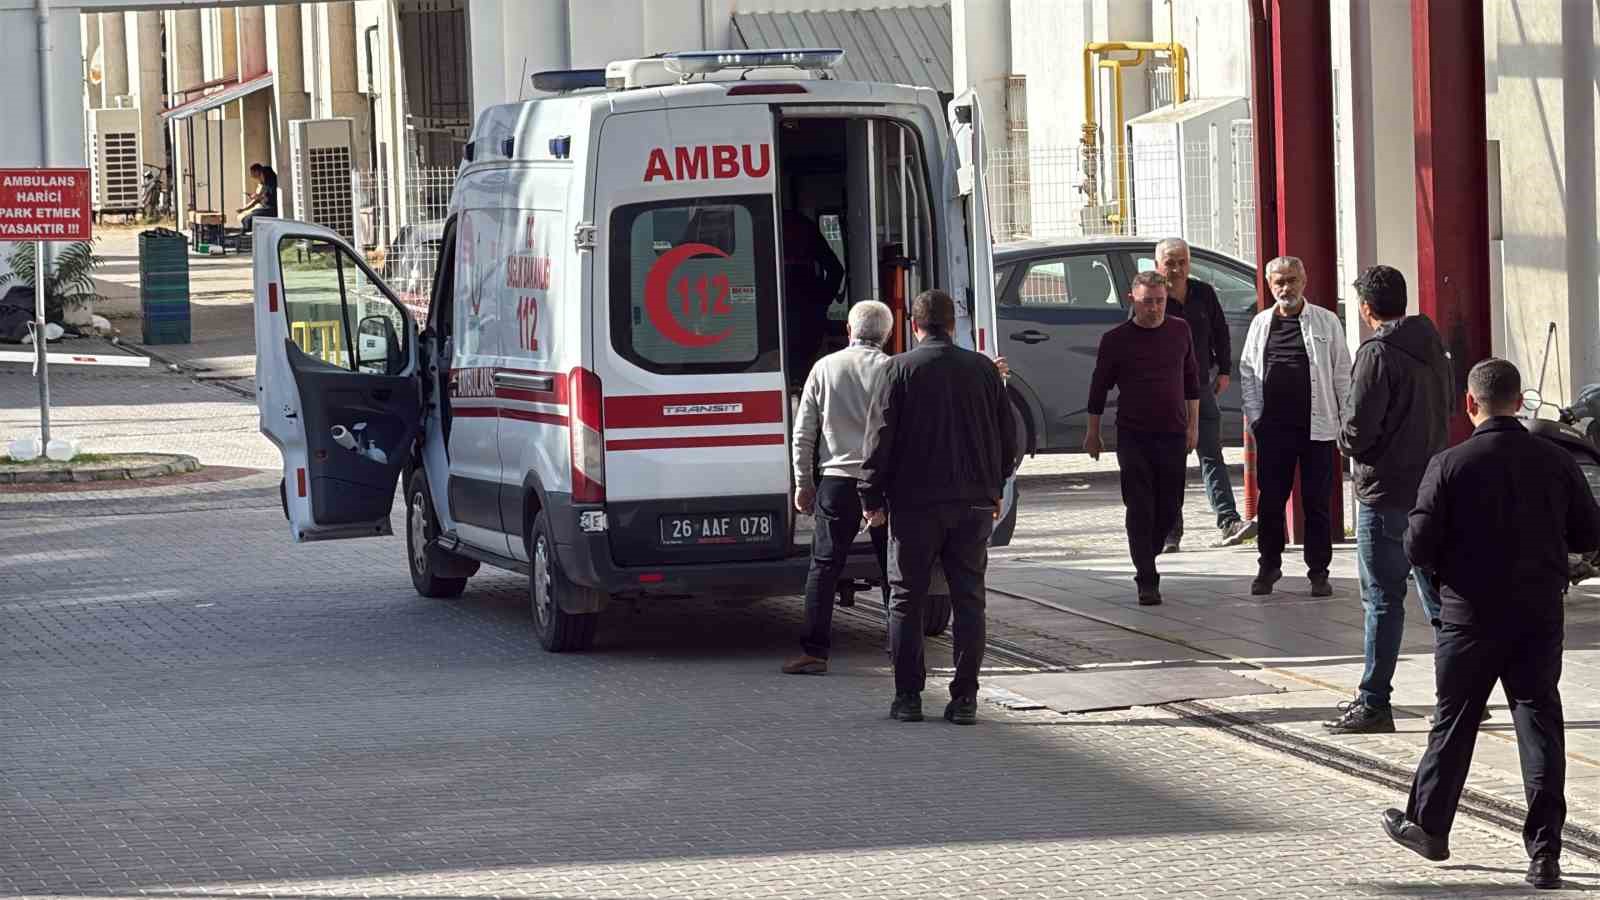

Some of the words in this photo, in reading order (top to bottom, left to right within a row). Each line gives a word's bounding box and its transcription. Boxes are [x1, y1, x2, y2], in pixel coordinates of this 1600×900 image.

[643, 143, 770, 182] AMBU
[3, 176, 75, 187] AMBULANS
[16, 190, 62, 202] HARİCİ
[0, 208, 32, 218] PARK
[36, 207, 81, 218] ETMEK
[0, 223, 65, 234] YASAKTIR
[68, 223, 80, 234] !!!
[675, 274, 733, 316] 112
[517, 295, 538, 352] 112
[458, 367, 496, 397] AMBULANS
[664, 404, 740, 413] TRANSIT
[672, 520, 692, 538] 26
[702, 518, 730, 536] AAF
[740, 516, 769, 535] 078
